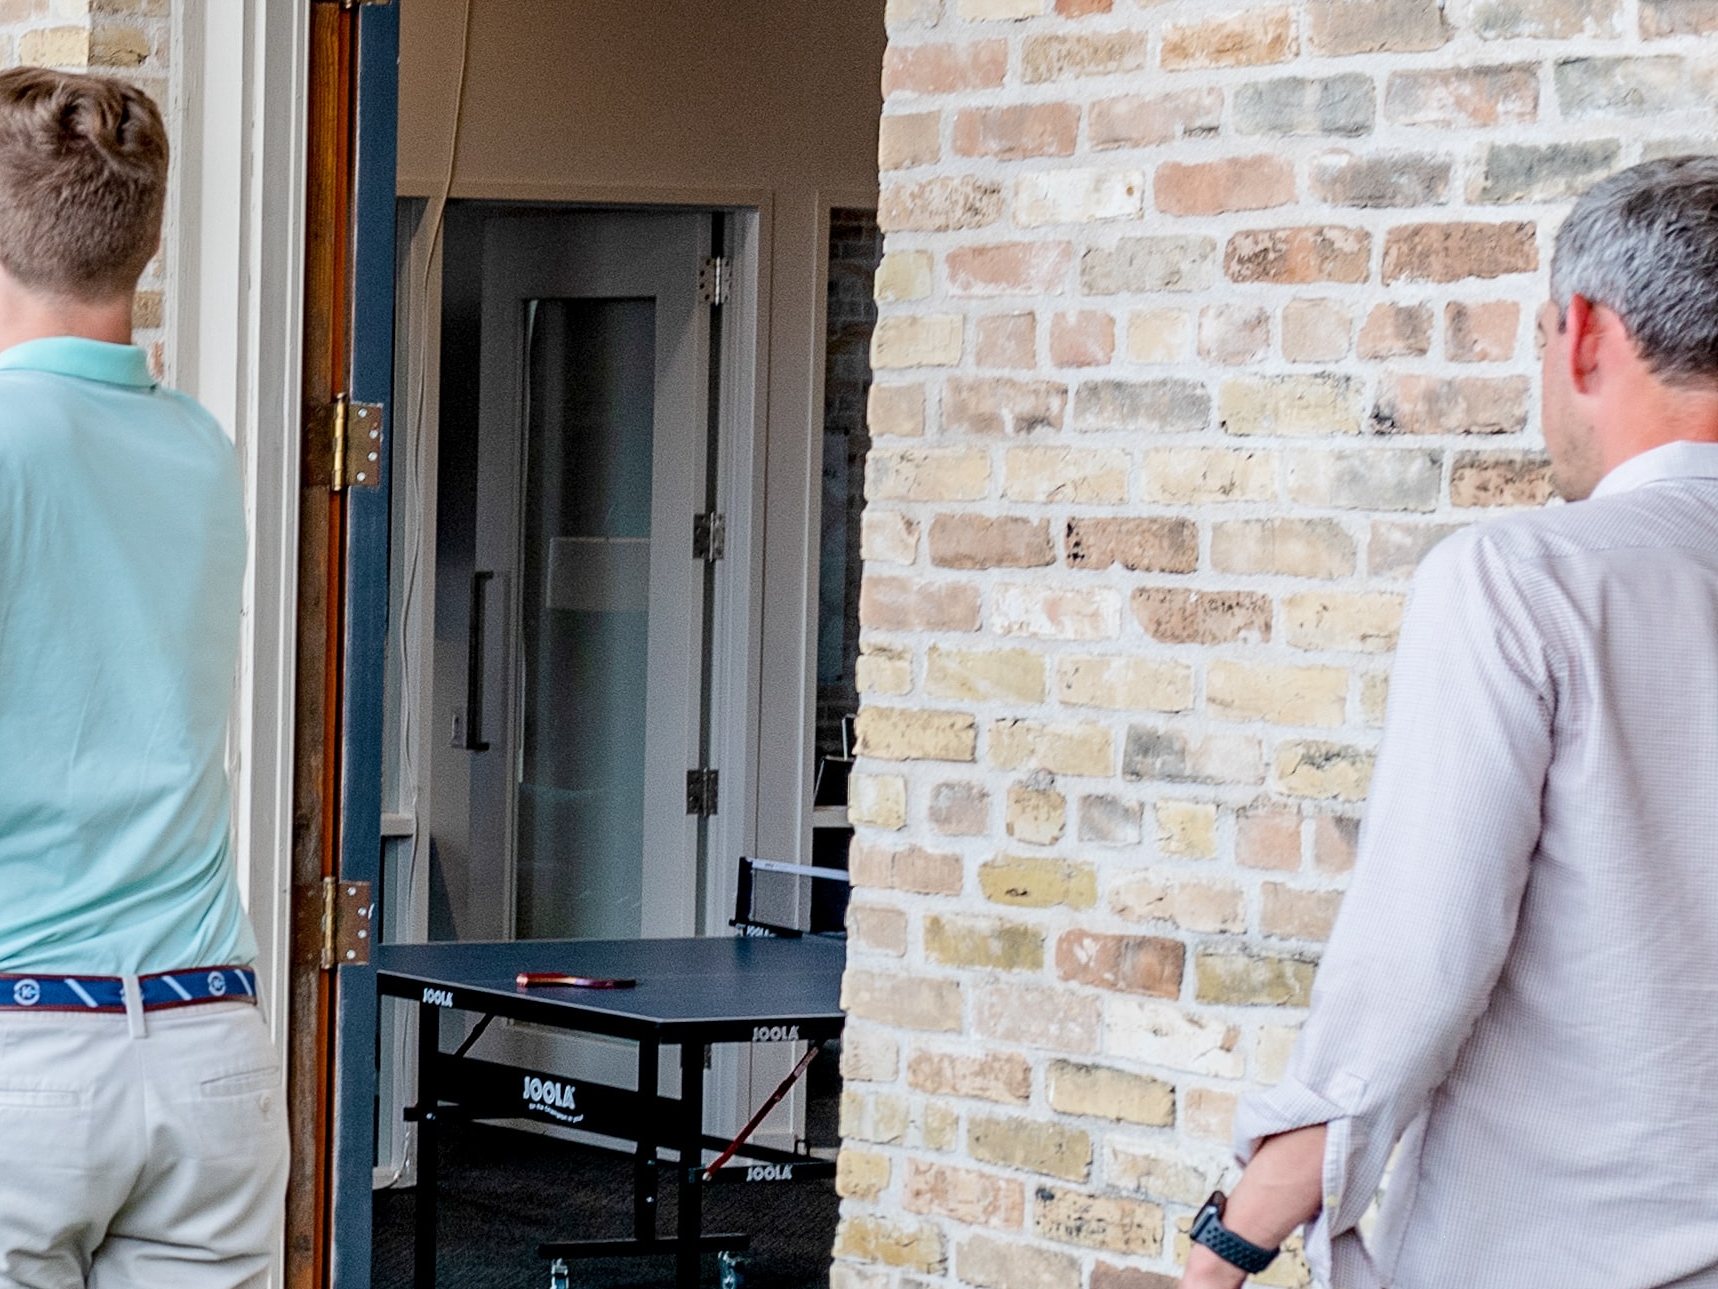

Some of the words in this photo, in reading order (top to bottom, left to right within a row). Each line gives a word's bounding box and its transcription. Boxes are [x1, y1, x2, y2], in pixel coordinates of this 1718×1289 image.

[422, 987, 453, 1008] JOOLA
[752, 1025, 799, 1042] JOOLA
[522, 1075, 576, 1110] JOOLA
[746, 1165, 793, 1182] JOOLA
